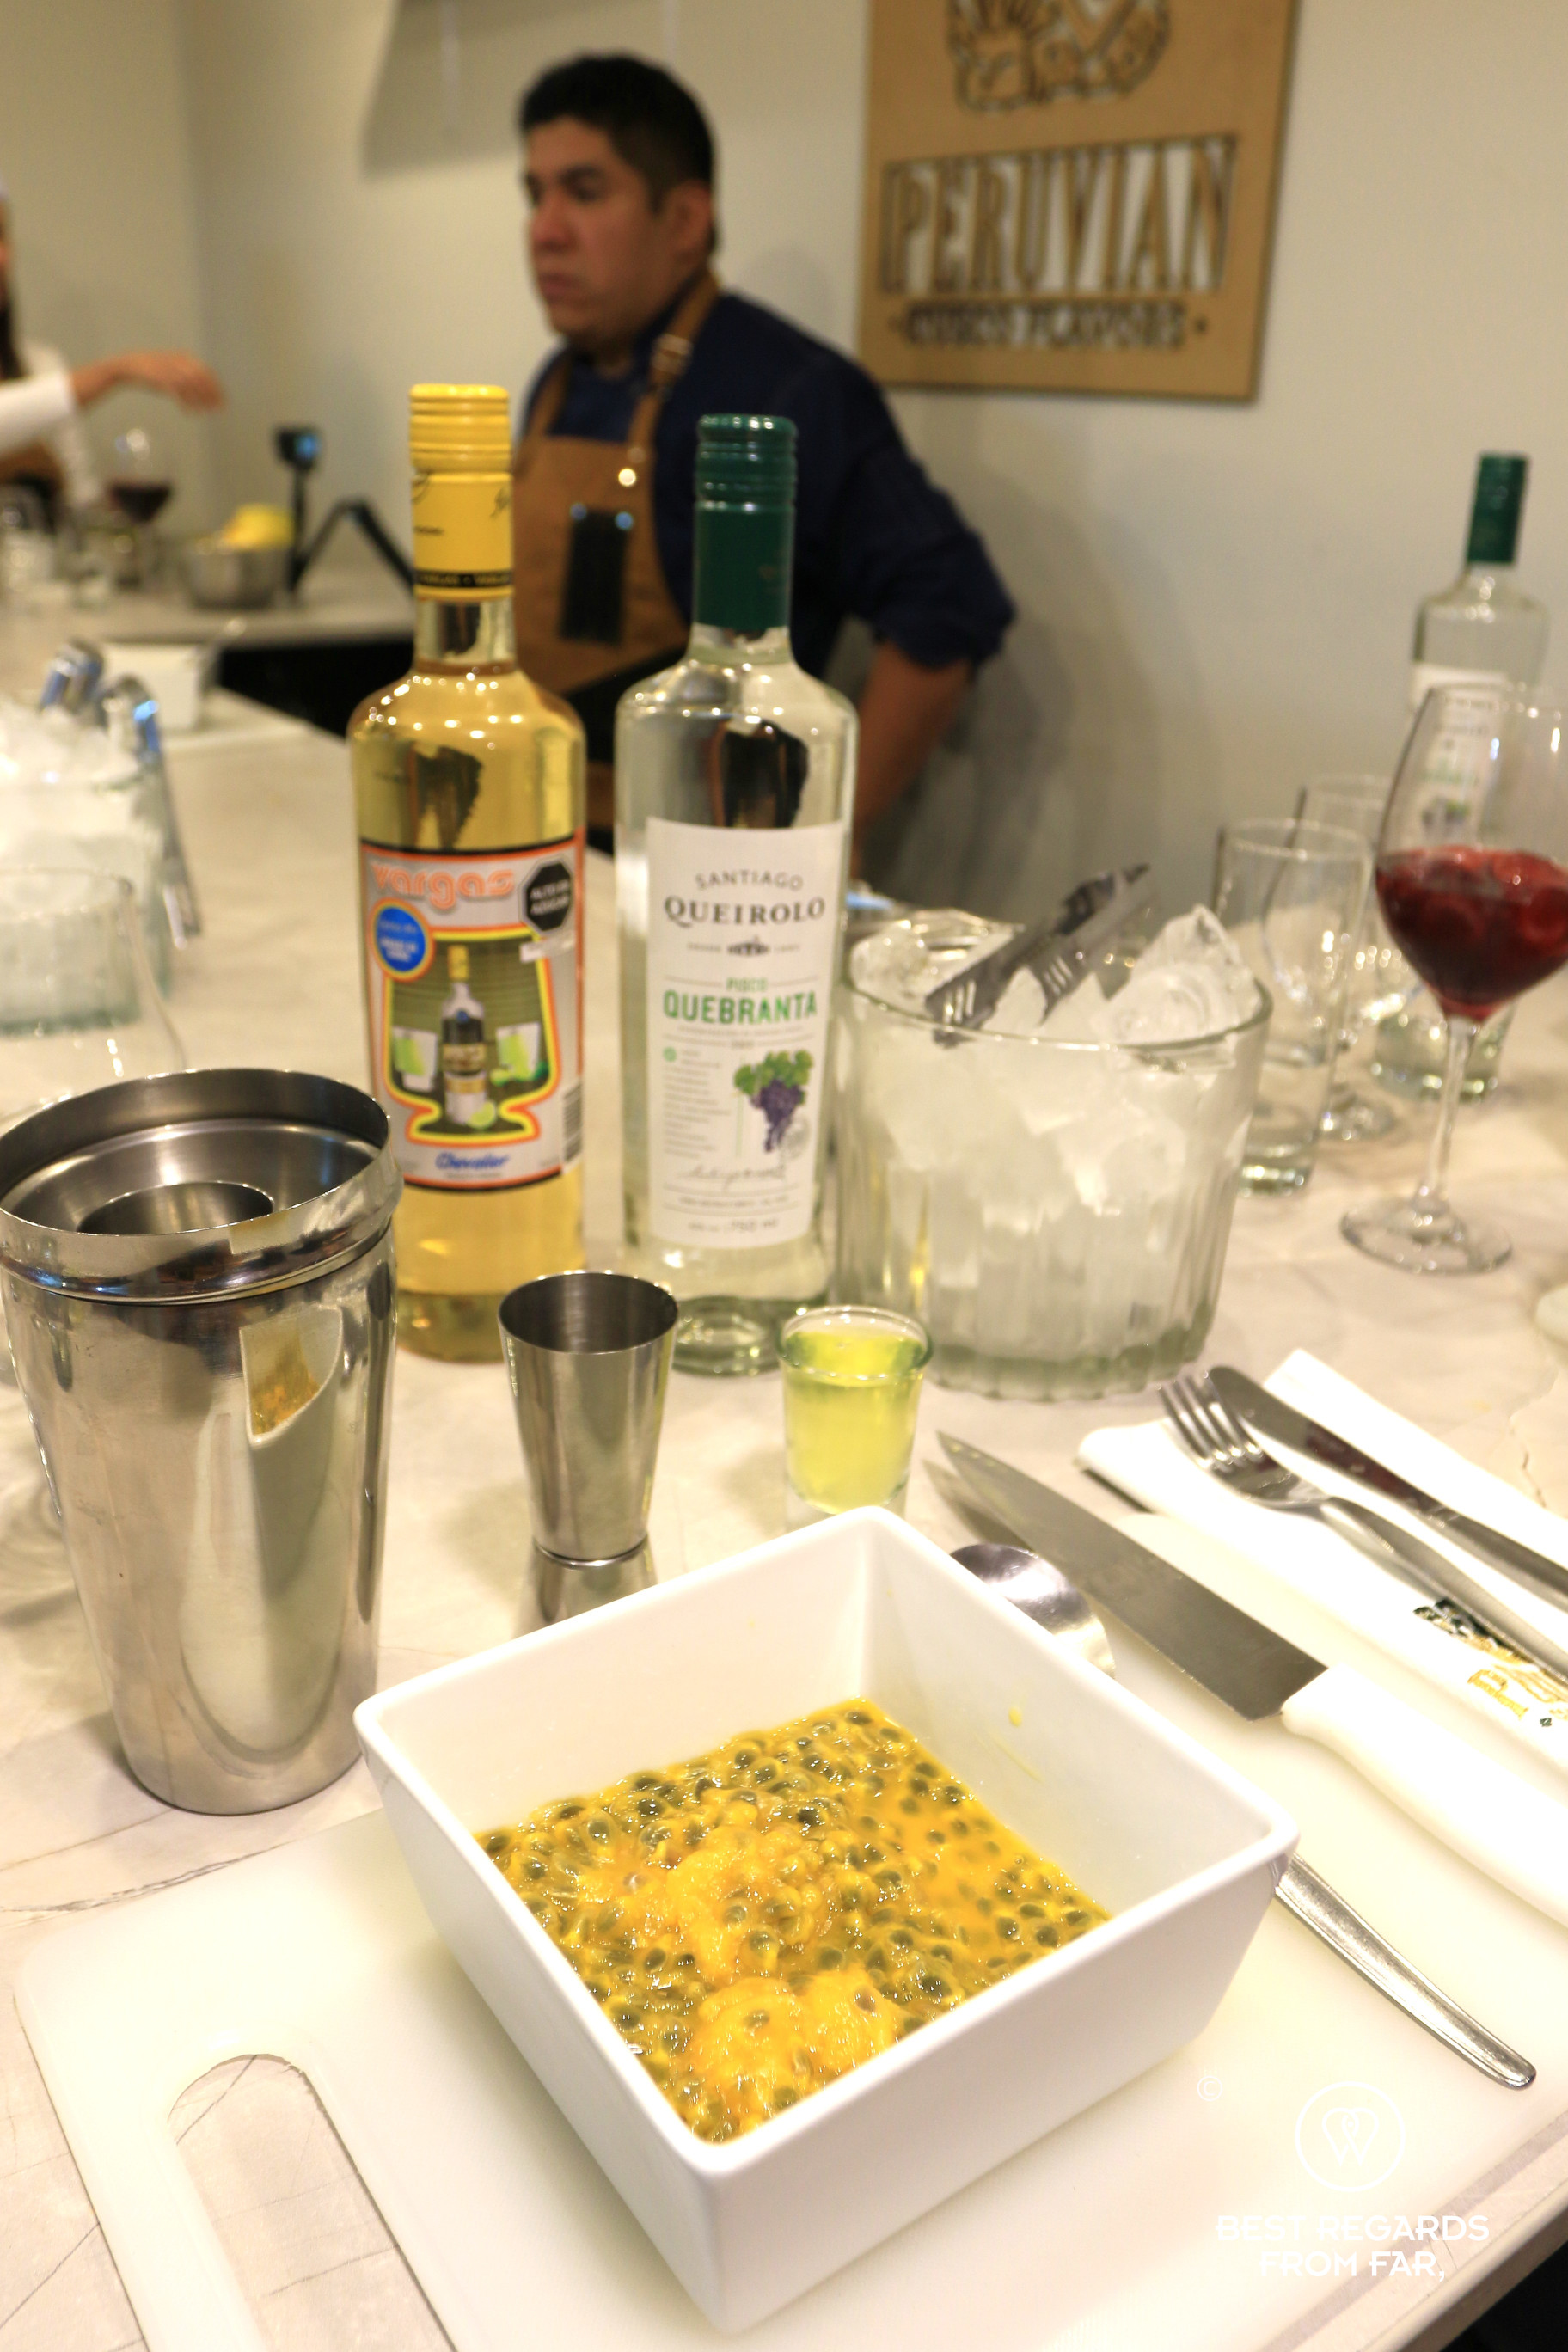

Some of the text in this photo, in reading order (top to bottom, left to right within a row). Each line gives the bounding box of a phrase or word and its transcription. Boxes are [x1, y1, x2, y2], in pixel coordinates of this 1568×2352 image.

[880, 132, 1237, 297] PERUVIAN
[371, 864, 514, 911] vargas
[695, 869, 804, 891] SANTIAGO
[664, 895, 825, 929] QUEIROLO
[663, 989, 817, 1025] QUEBRANTA
